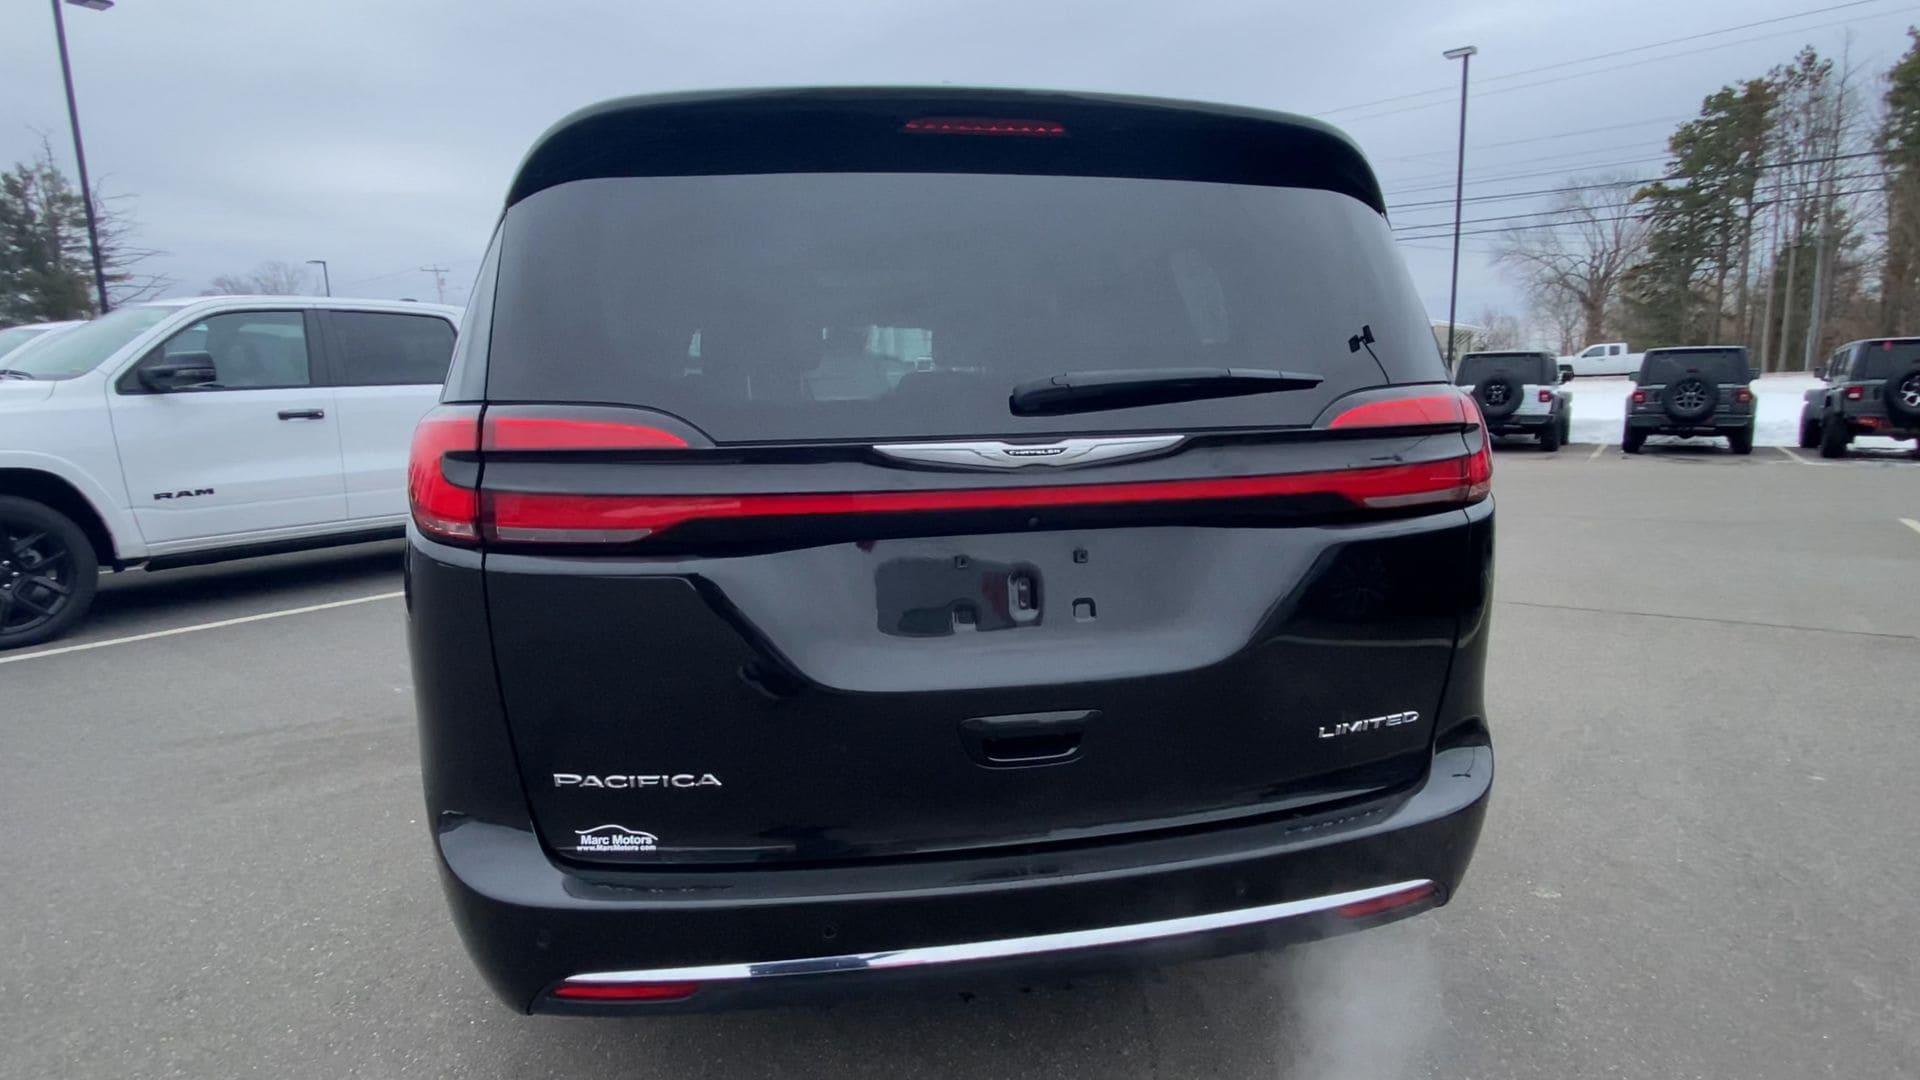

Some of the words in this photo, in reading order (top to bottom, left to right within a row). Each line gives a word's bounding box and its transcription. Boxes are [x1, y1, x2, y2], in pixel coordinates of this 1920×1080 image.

[153, 488, 214, 500] RAM
[1318, 710, 1420, 738] LIMITED
[553, 773, 723, 788] PACIFICA
[580, 834, 610, 845] Marc
[612, 834, 653, 845] Motors
